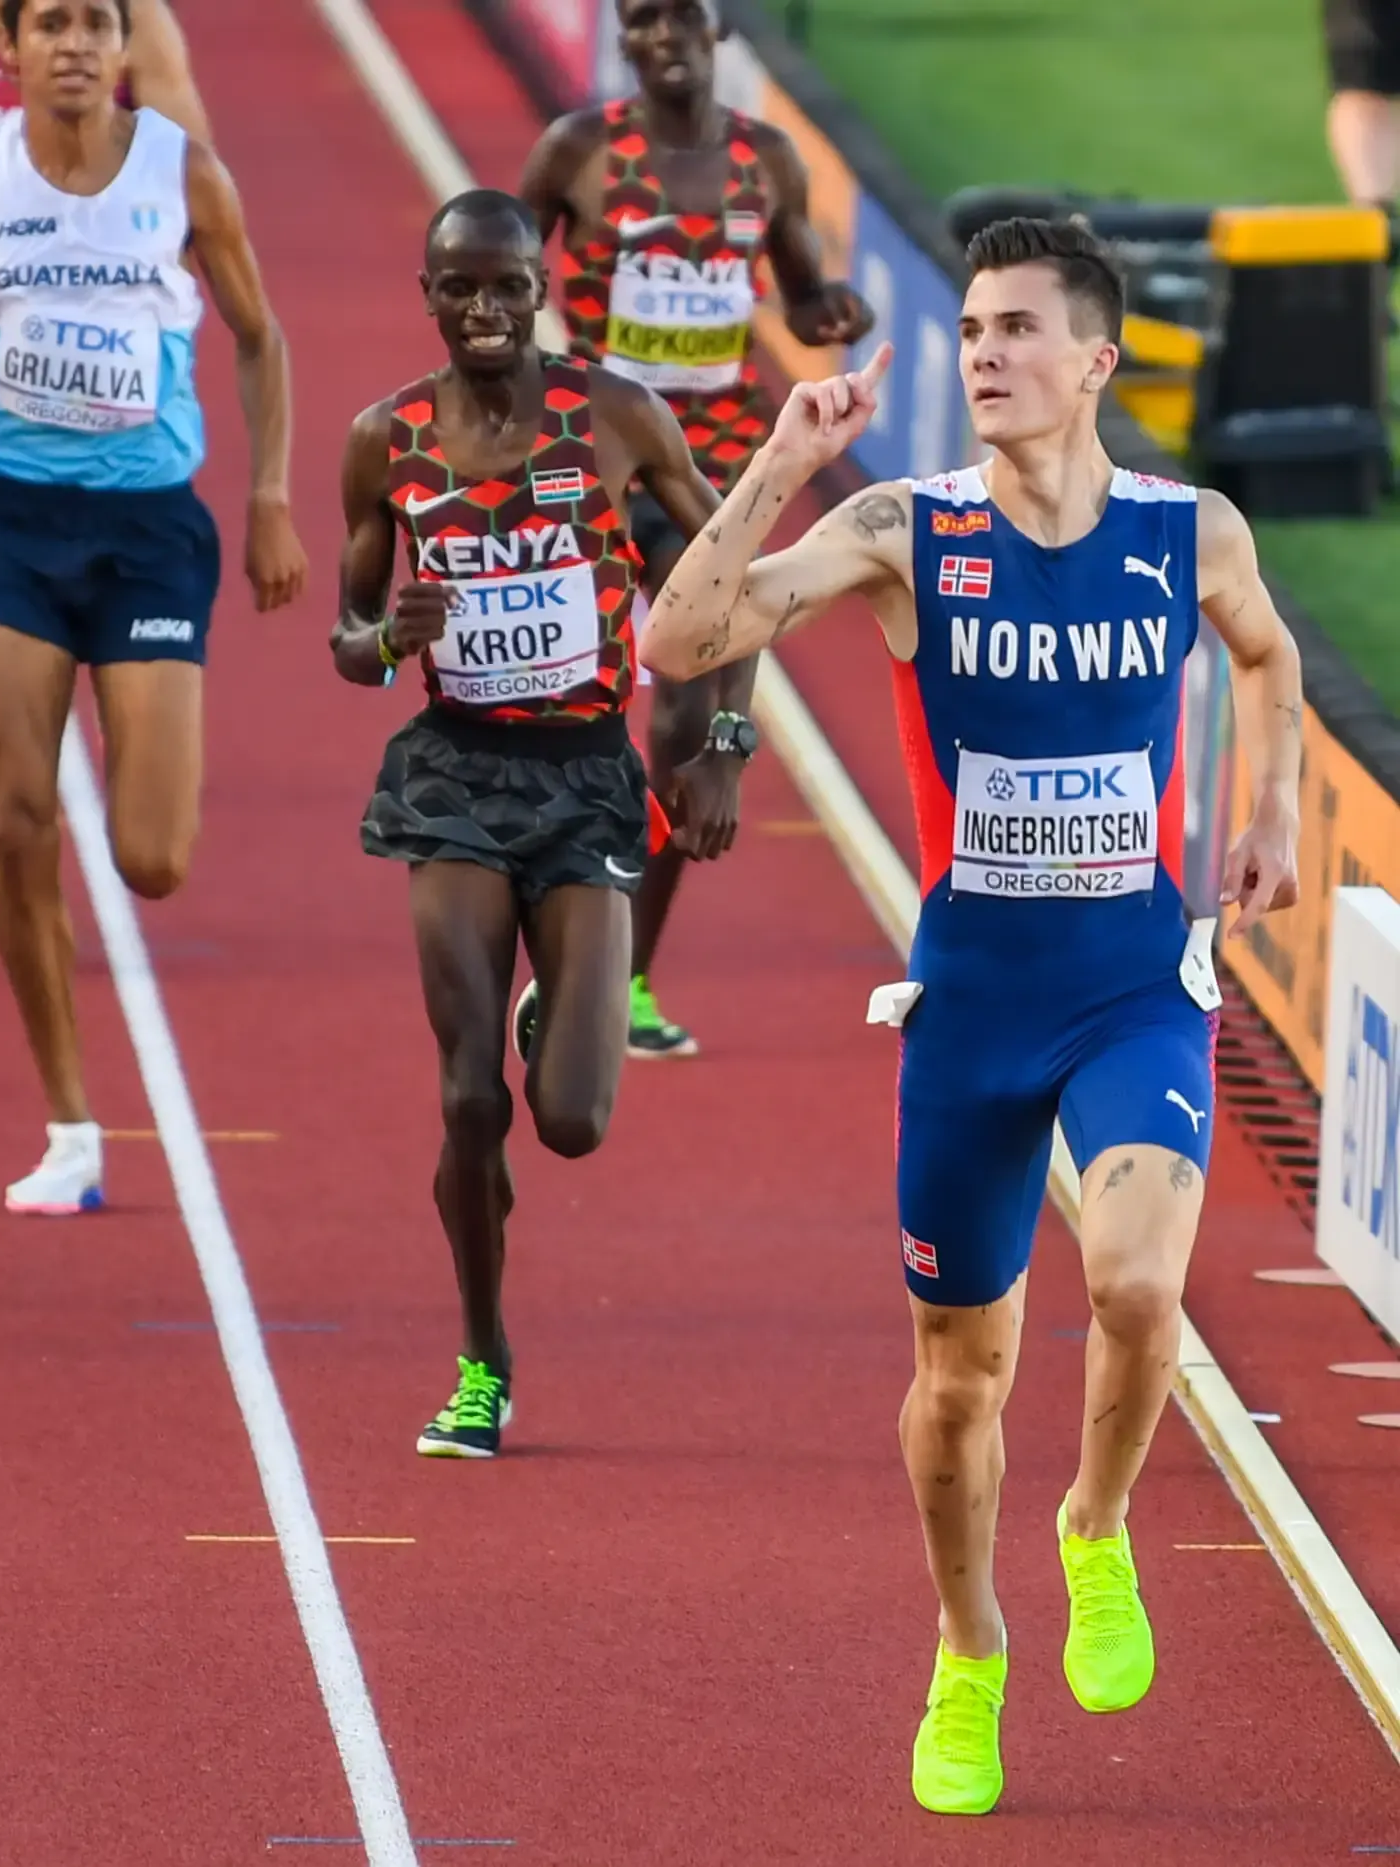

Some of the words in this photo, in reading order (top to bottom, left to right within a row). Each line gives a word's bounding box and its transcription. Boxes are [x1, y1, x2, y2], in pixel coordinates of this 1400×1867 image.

[663, 291, 735, 318] TDK
[48, 319, 135, 355] TDK
[4, 347, 145, 402] GRIJALVA
[417, 524, 582, 572] KENYA
[468, 577, 568, 615] TDK
[130, 618, 195, 642] HOKA
[457, 622, 562, 666] KROP
[951, 616, 1168, 683] NORWAY
[457, 667, 576, 698] OREGON22
[1016, 765, 1128, 801] TDK
[962, 810, 1149, 857] INGEBRIGTSEN
[984, 871, 1124, 893] OREGON22
